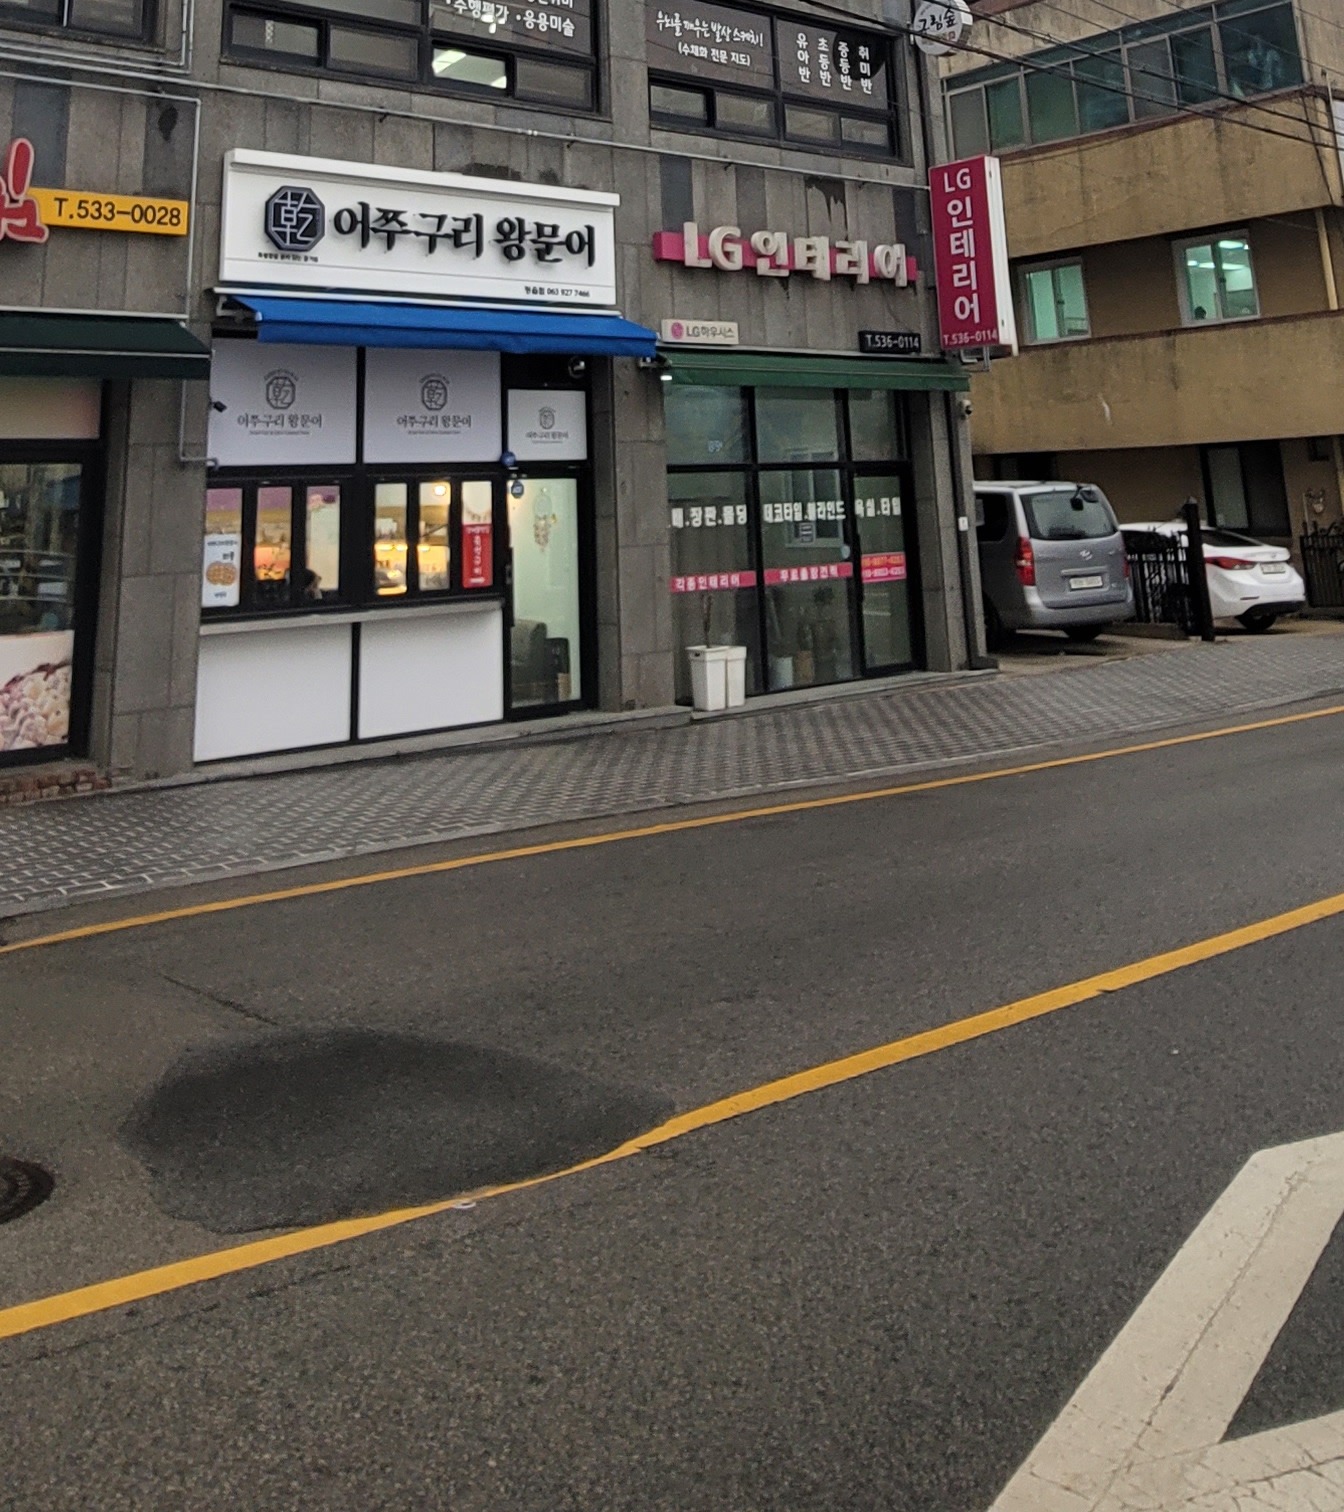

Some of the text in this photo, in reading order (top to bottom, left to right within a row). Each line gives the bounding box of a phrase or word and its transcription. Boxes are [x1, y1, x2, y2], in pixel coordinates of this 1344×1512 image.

[522, 9, 575, 37] 응용미술
[711, 21, 732, 44] 발상
[710, 48, 728, 65] 전문
[730, 51, 751, 67] 지도)
[796, 33, 810, 83] 유아반
[818, 37, 831, 87] 초등반
[838, 41, 852, 91] 중등반
[858, 45, 872, 94] 취미반
[943, 168, 972, 194] LG
[52, 195, 183, 230] T.533-0028
[333, 201, 596, 268] 어쭈구리 왕문어
[946, 196, 981, 324] 인테리어
[865, 333, 920, 350] T.536-0114
[943, 328, 999, 346] T.536-0114
